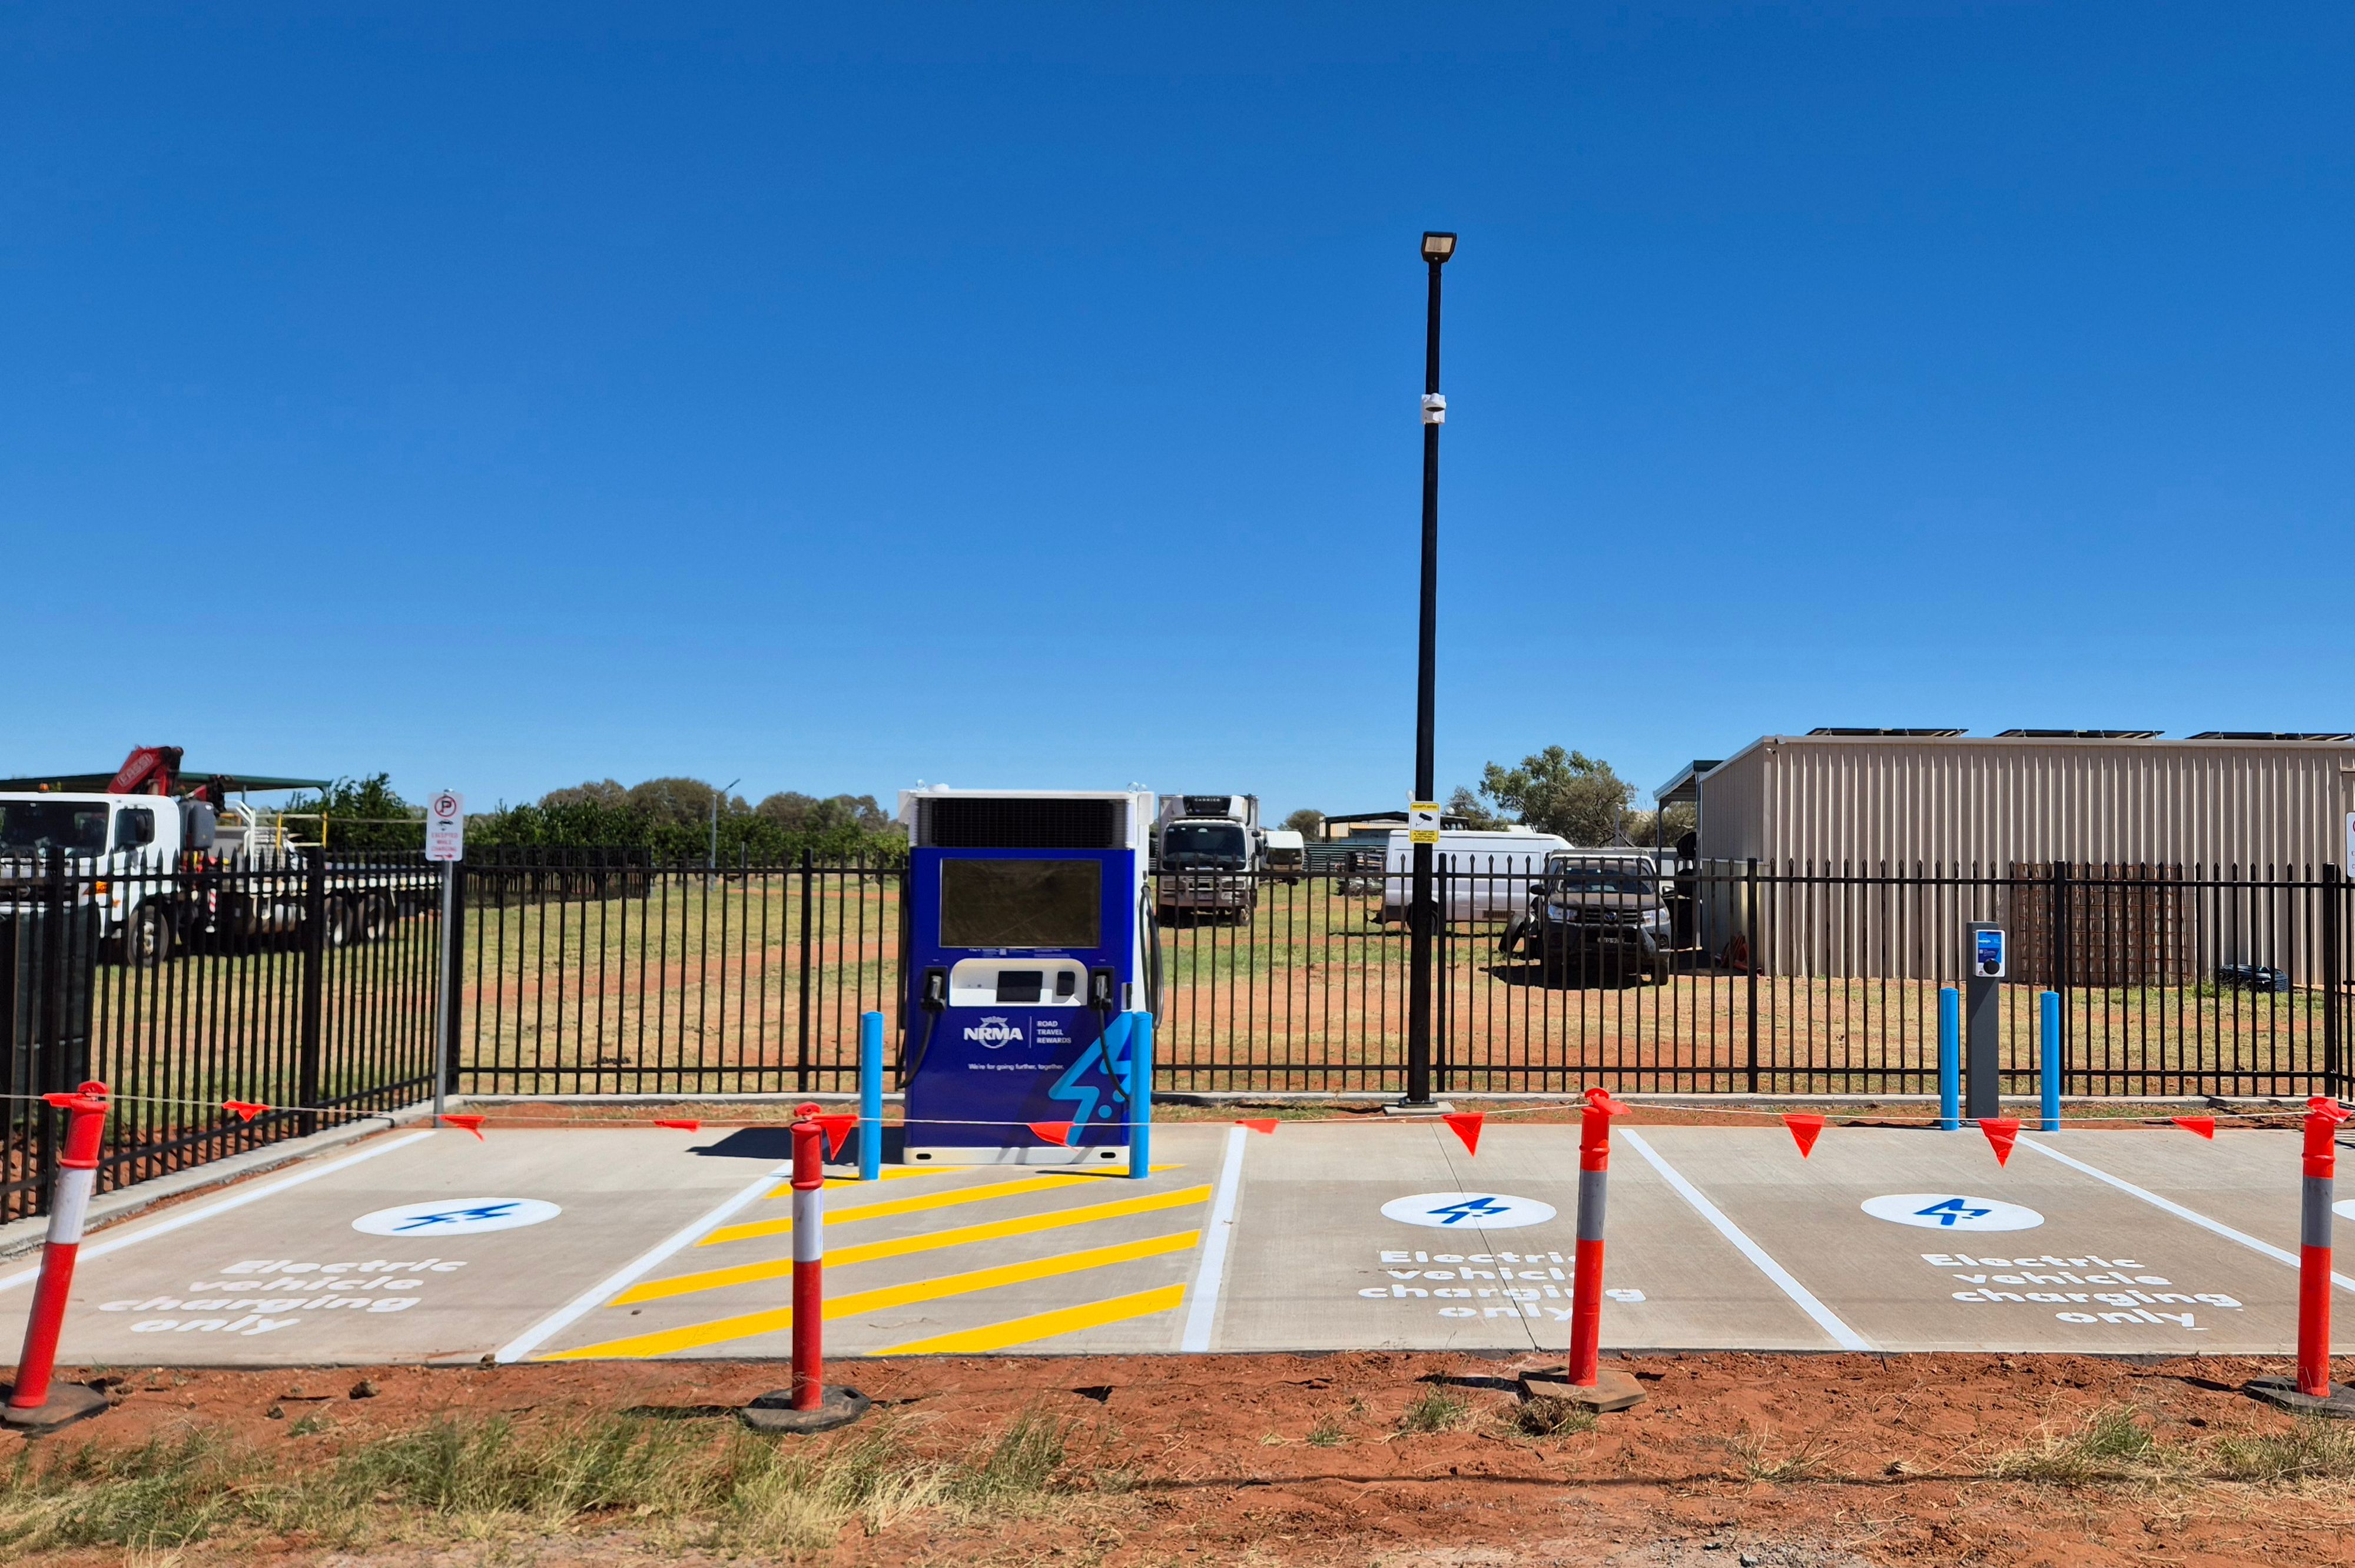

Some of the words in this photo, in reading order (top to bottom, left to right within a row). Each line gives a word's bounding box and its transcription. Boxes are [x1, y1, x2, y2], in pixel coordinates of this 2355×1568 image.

[963, 1027, 1023, 1041] NRMA
[1379, 1250, 1576, 1263] Electri
[1921, 1254, 2145, 1268] Electric
[220, 1258, 467, 1274] Electric
[1387, 1267, 1575, 1280] vehicl
[189, 1275, 424, 1292] vehicle
[1952, 1271, 2172, 1285] vehicle
[1358, 1284, 1647, 1303] chargig
[1952, 1288, 2243, 1307] charging
[98, 1294, 422, 1313] charging
[130, 1314, 301, 1336] only
[2055, 1308, 2195, 1328] only
